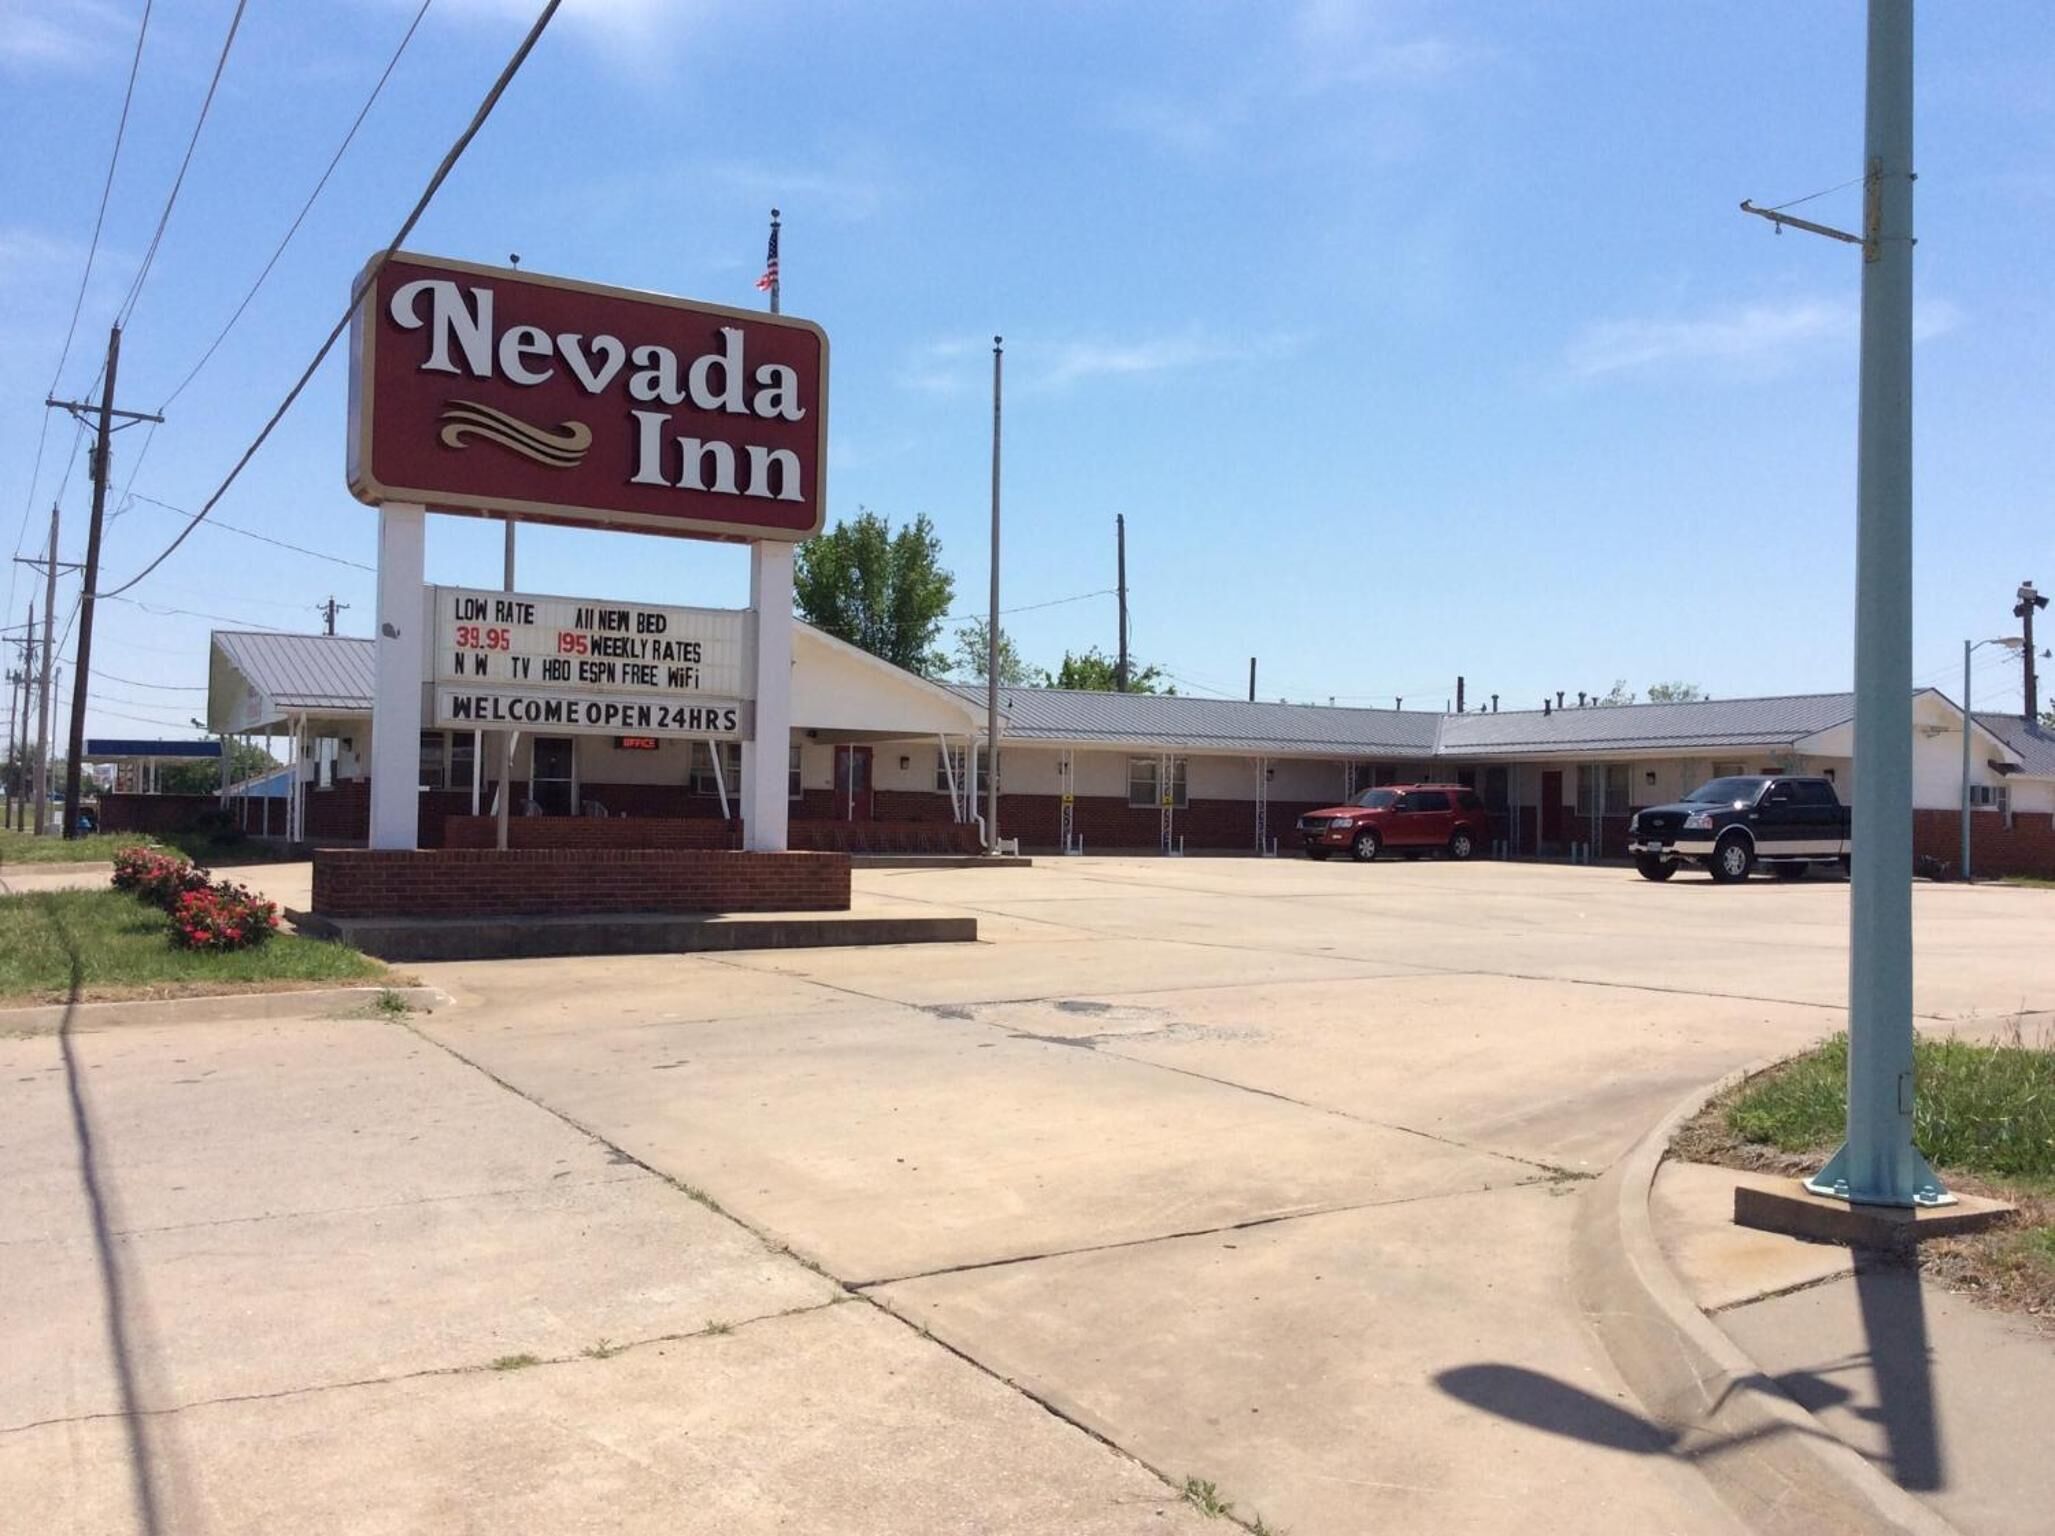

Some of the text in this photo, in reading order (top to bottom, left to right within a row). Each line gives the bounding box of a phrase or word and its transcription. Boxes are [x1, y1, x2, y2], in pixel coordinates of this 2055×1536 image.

[390, 280, 806, 422] Nevada
[630, 409, 805, 503] Inn
[456, 598, 534, 624] LOW RATE
[598, 609, 630, 632] NEW
[637, 612, 667, 634] BED
[456, 626, 510, 650] 39.95
[558, 632, 702, 663] 195 WEEKLY RATES
[511, 657, 530, 679] TV
[543, 659, 570, 681] HBO
[579, 661, 616, 683] ESPN
[622, 663, 658, 686] FREE
[453, 696, 579, 723] WELCOME
[586, 702, 651, 726] OPEN
